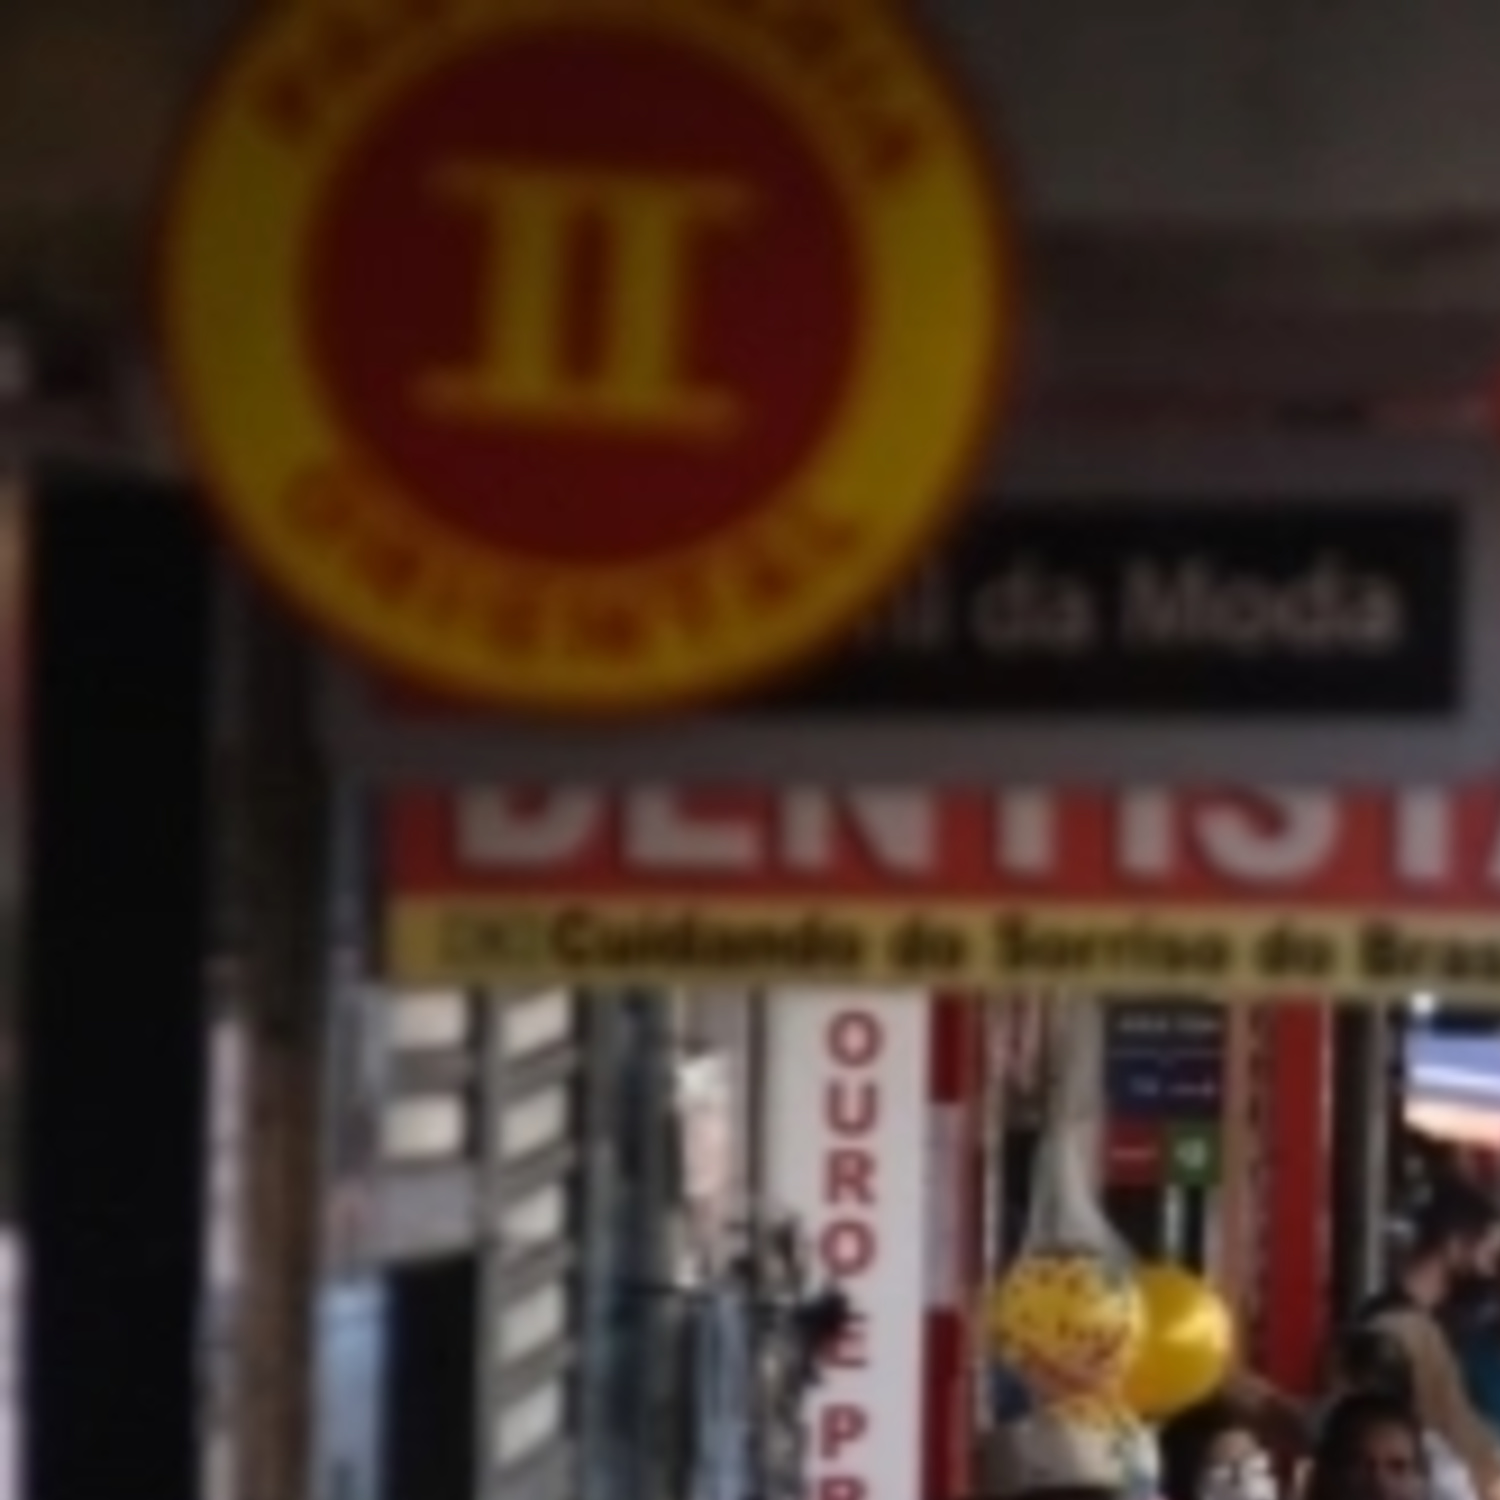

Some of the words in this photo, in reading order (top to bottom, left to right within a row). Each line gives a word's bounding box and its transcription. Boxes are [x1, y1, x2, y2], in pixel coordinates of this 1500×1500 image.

[972, 552, 1096, 655] da
[1120, 555, 1408, 655] Moda
[549, 906, 862, 974] Cuidando
[1002, 914, 1228, 978] Sorriso
[819, 1009, 884, 1278] OURO
